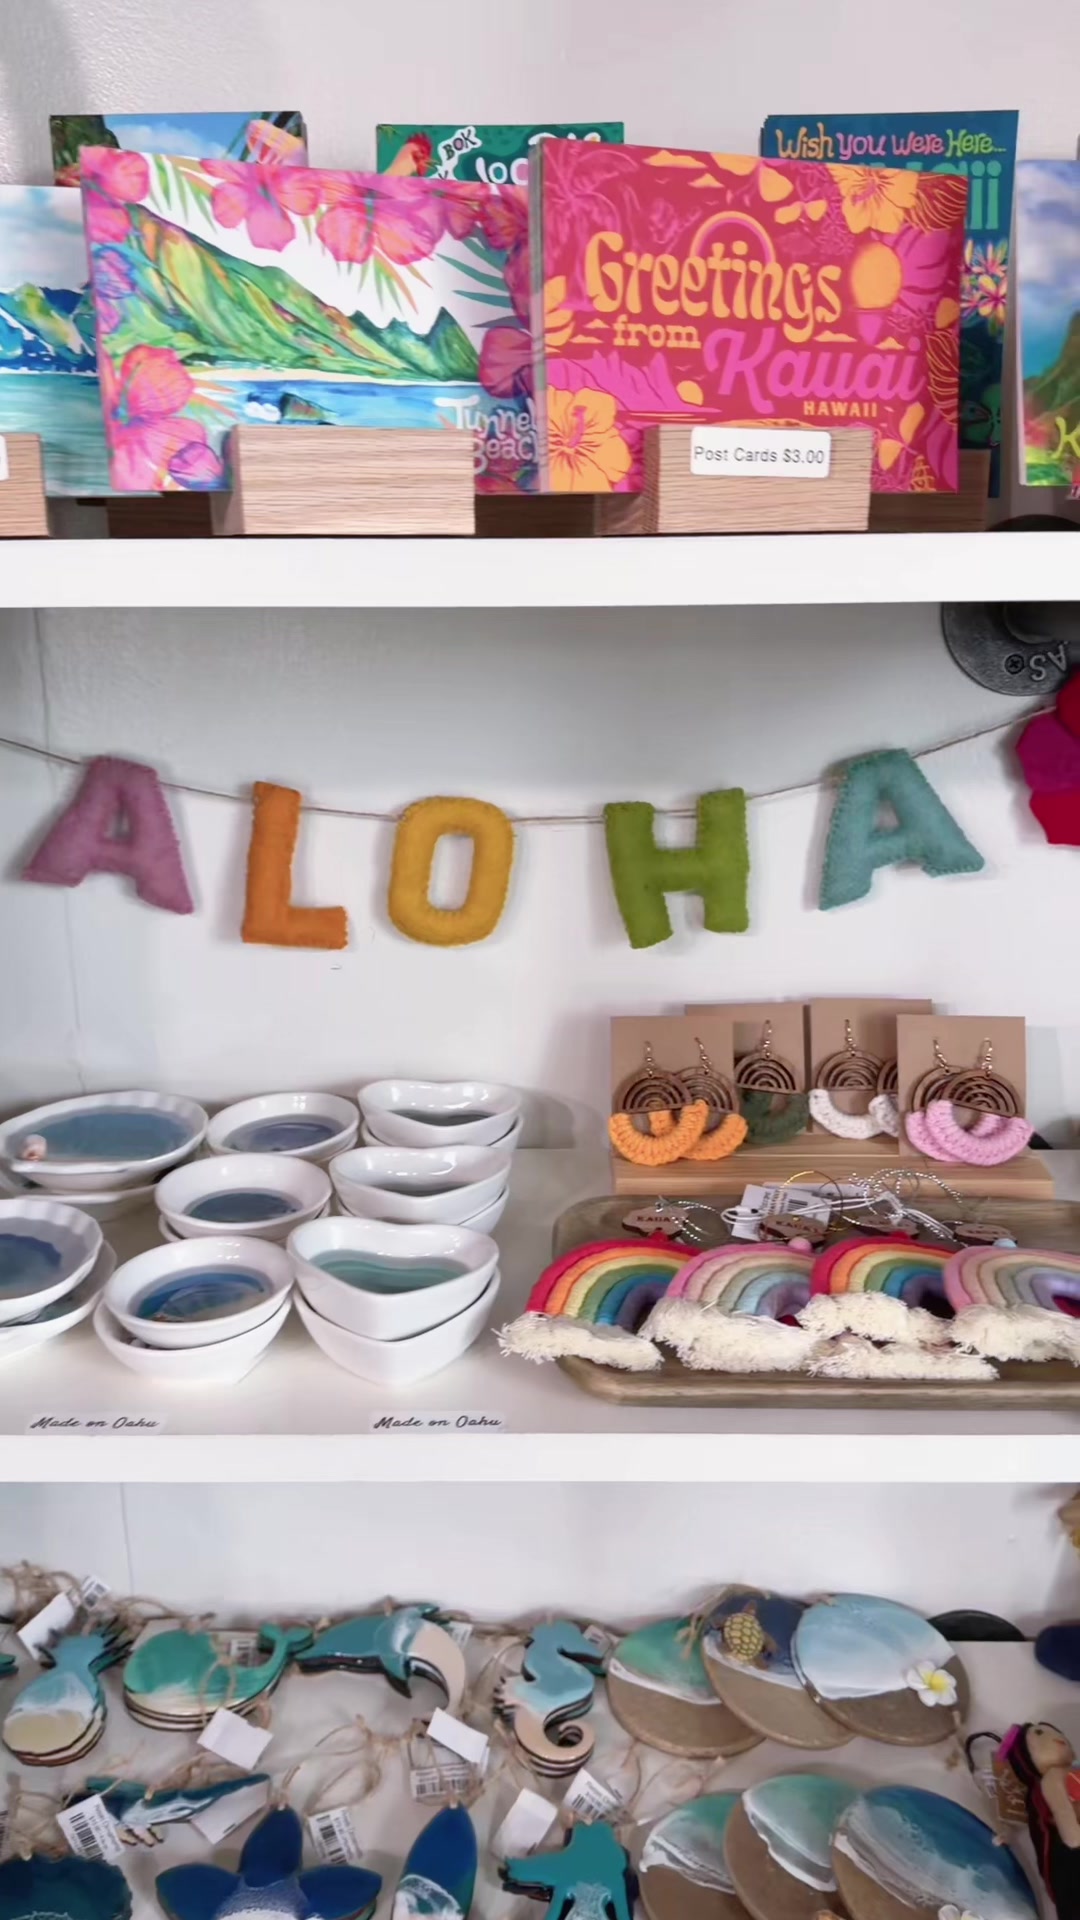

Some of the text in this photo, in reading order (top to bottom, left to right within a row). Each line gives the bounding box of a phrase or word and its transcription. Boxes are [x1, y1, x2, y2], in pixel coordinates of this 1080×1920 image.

[442, 130, 478, 161] BOK
[775, 121, 834, 159] Wish
[836, 132, 887, 160] you
[585, 231, 842, 343] Greetings
[613, 314, 702, 349] from
[703, 327, 926, 414] Kauai
[803, 400, 878, 427] HAWAII
[694, 446, 825, 463] Post Cards $3.00
[21, 748, 985, 950] ALOHA
[30, 1415, 159, 1429] Made on Oahu
[374, 1415, 502, 1429] Made on Oahu
